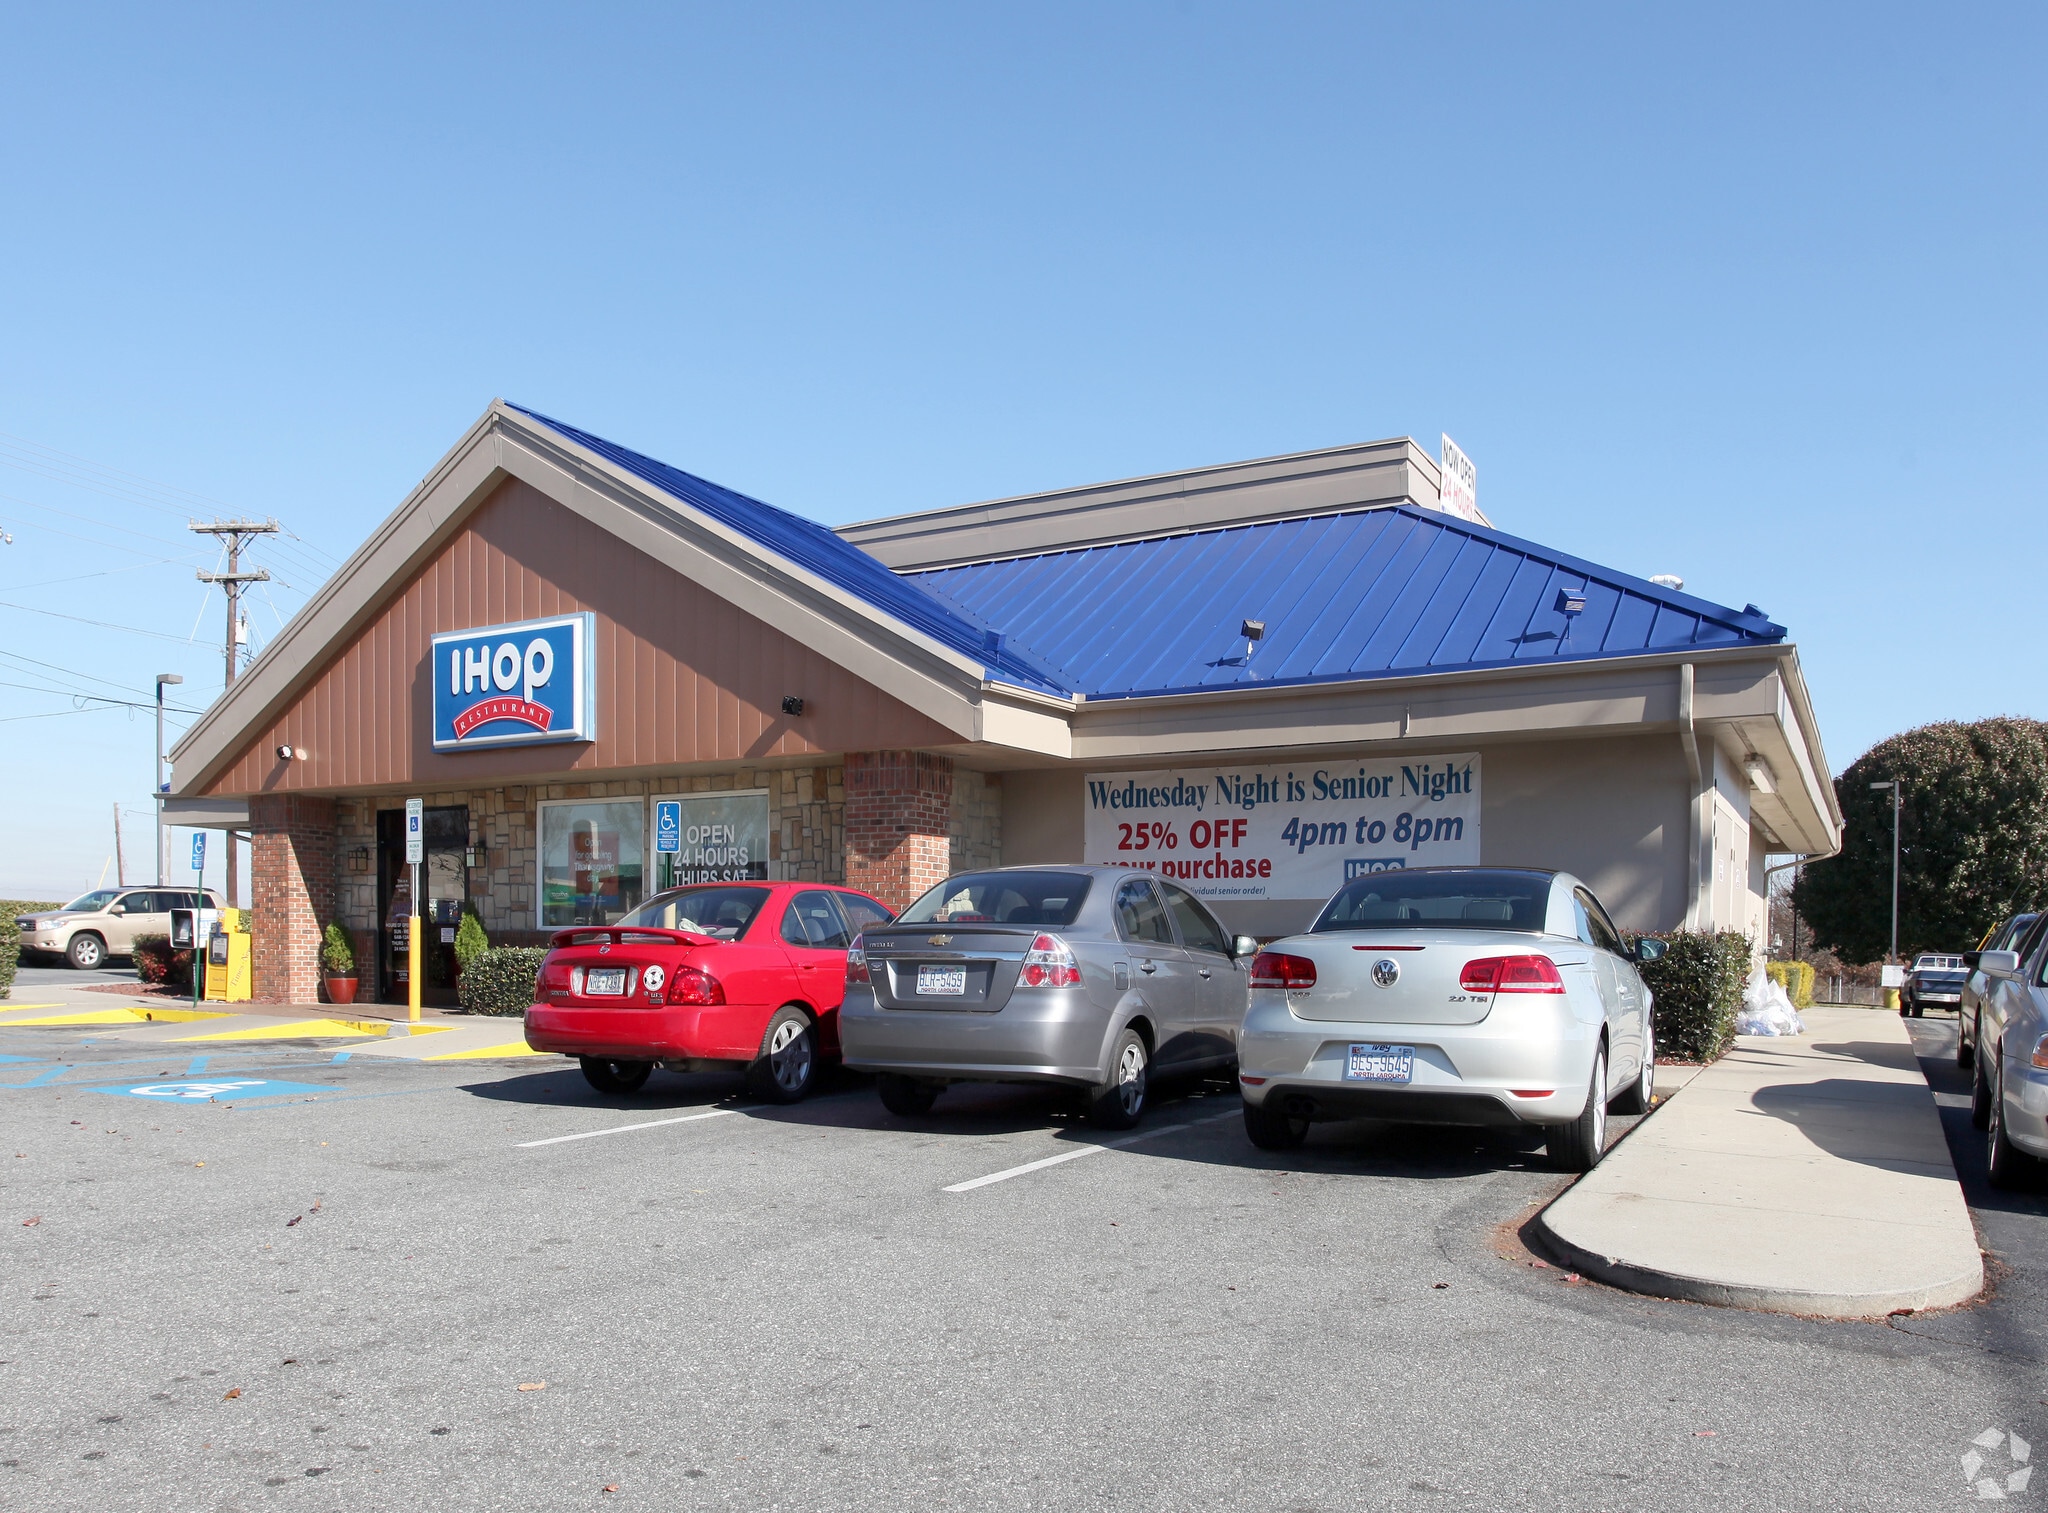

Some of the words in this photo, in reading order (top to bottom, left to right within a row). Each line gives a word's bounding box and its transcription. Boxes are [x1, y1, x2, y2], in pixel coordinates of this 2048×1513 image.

[1443, 439, 1459, 474] NOW
[1460, 457, 1475, 493] OPEN
[451, 638, 554, 703] IHOP
[460, 704, 544, 730] RESTAURANT
[1088, 778, 1209, 812] Wednesday
[1215, 774, 1280, 810] Night
[1286, 772, 1306, 802] is
[1312, 768, 1394, 801] Senior
[1400, 763, 1473, 802] Night
[686, 824, 735, 844] OPEN
[1118, 821, 1178, 850] 25%
[1189, 819, 1248, 849] OFF
[1281, 817, 1347, 854] 4pm
[1355, 816, 1386, 844] to
[1393, 812, 1464, 850] 8pm
[585, 850, 612, 861] goling
[674, 848, 691, 867] 24
[695, 846, 749, 867] HOURS
[1162, 852, 1272, 880] purchase
[574, 862, 615, 873] Thanksgiving
[674, 869, 749, 887] THURS-SAT
[1218, 887, 1241, 895] senior
[1242, 886, 1266, 895] order)
[919, 972, 963, 988] BLR-5459
[1351, 1053, 1410, 1073] BES-9645
